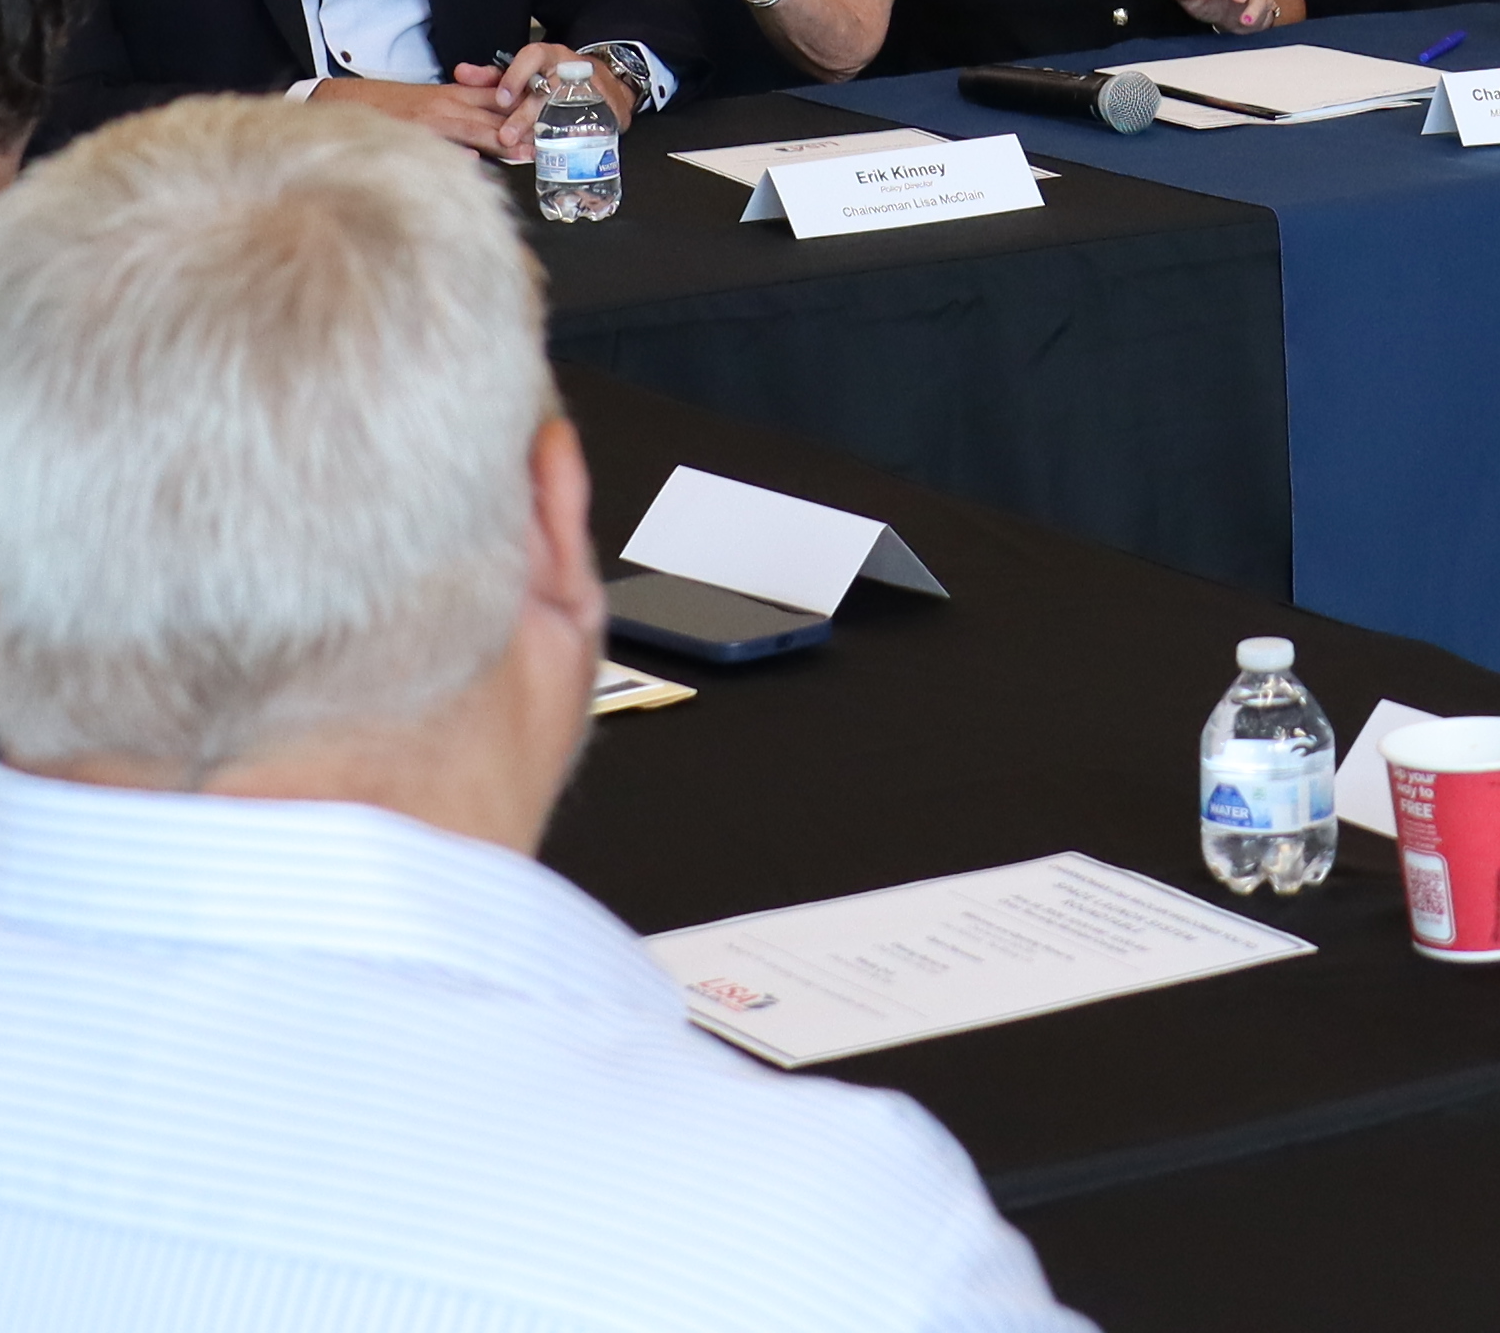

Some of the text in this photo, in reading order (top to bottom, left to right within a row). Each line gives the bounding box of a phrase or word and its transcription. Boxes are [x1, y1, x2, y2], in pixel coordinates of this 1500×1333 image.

[855, 160, 947, 185] Erik Kinney
[880, 180, 933, 194] Policy Director
[842, 188, 985, 218] Chairwoman Lisa McClain
[1408, 771, 1437, 784] your
[1419, 786, 1435, 799] to
[1210, 804, 1250, 819] WATER
